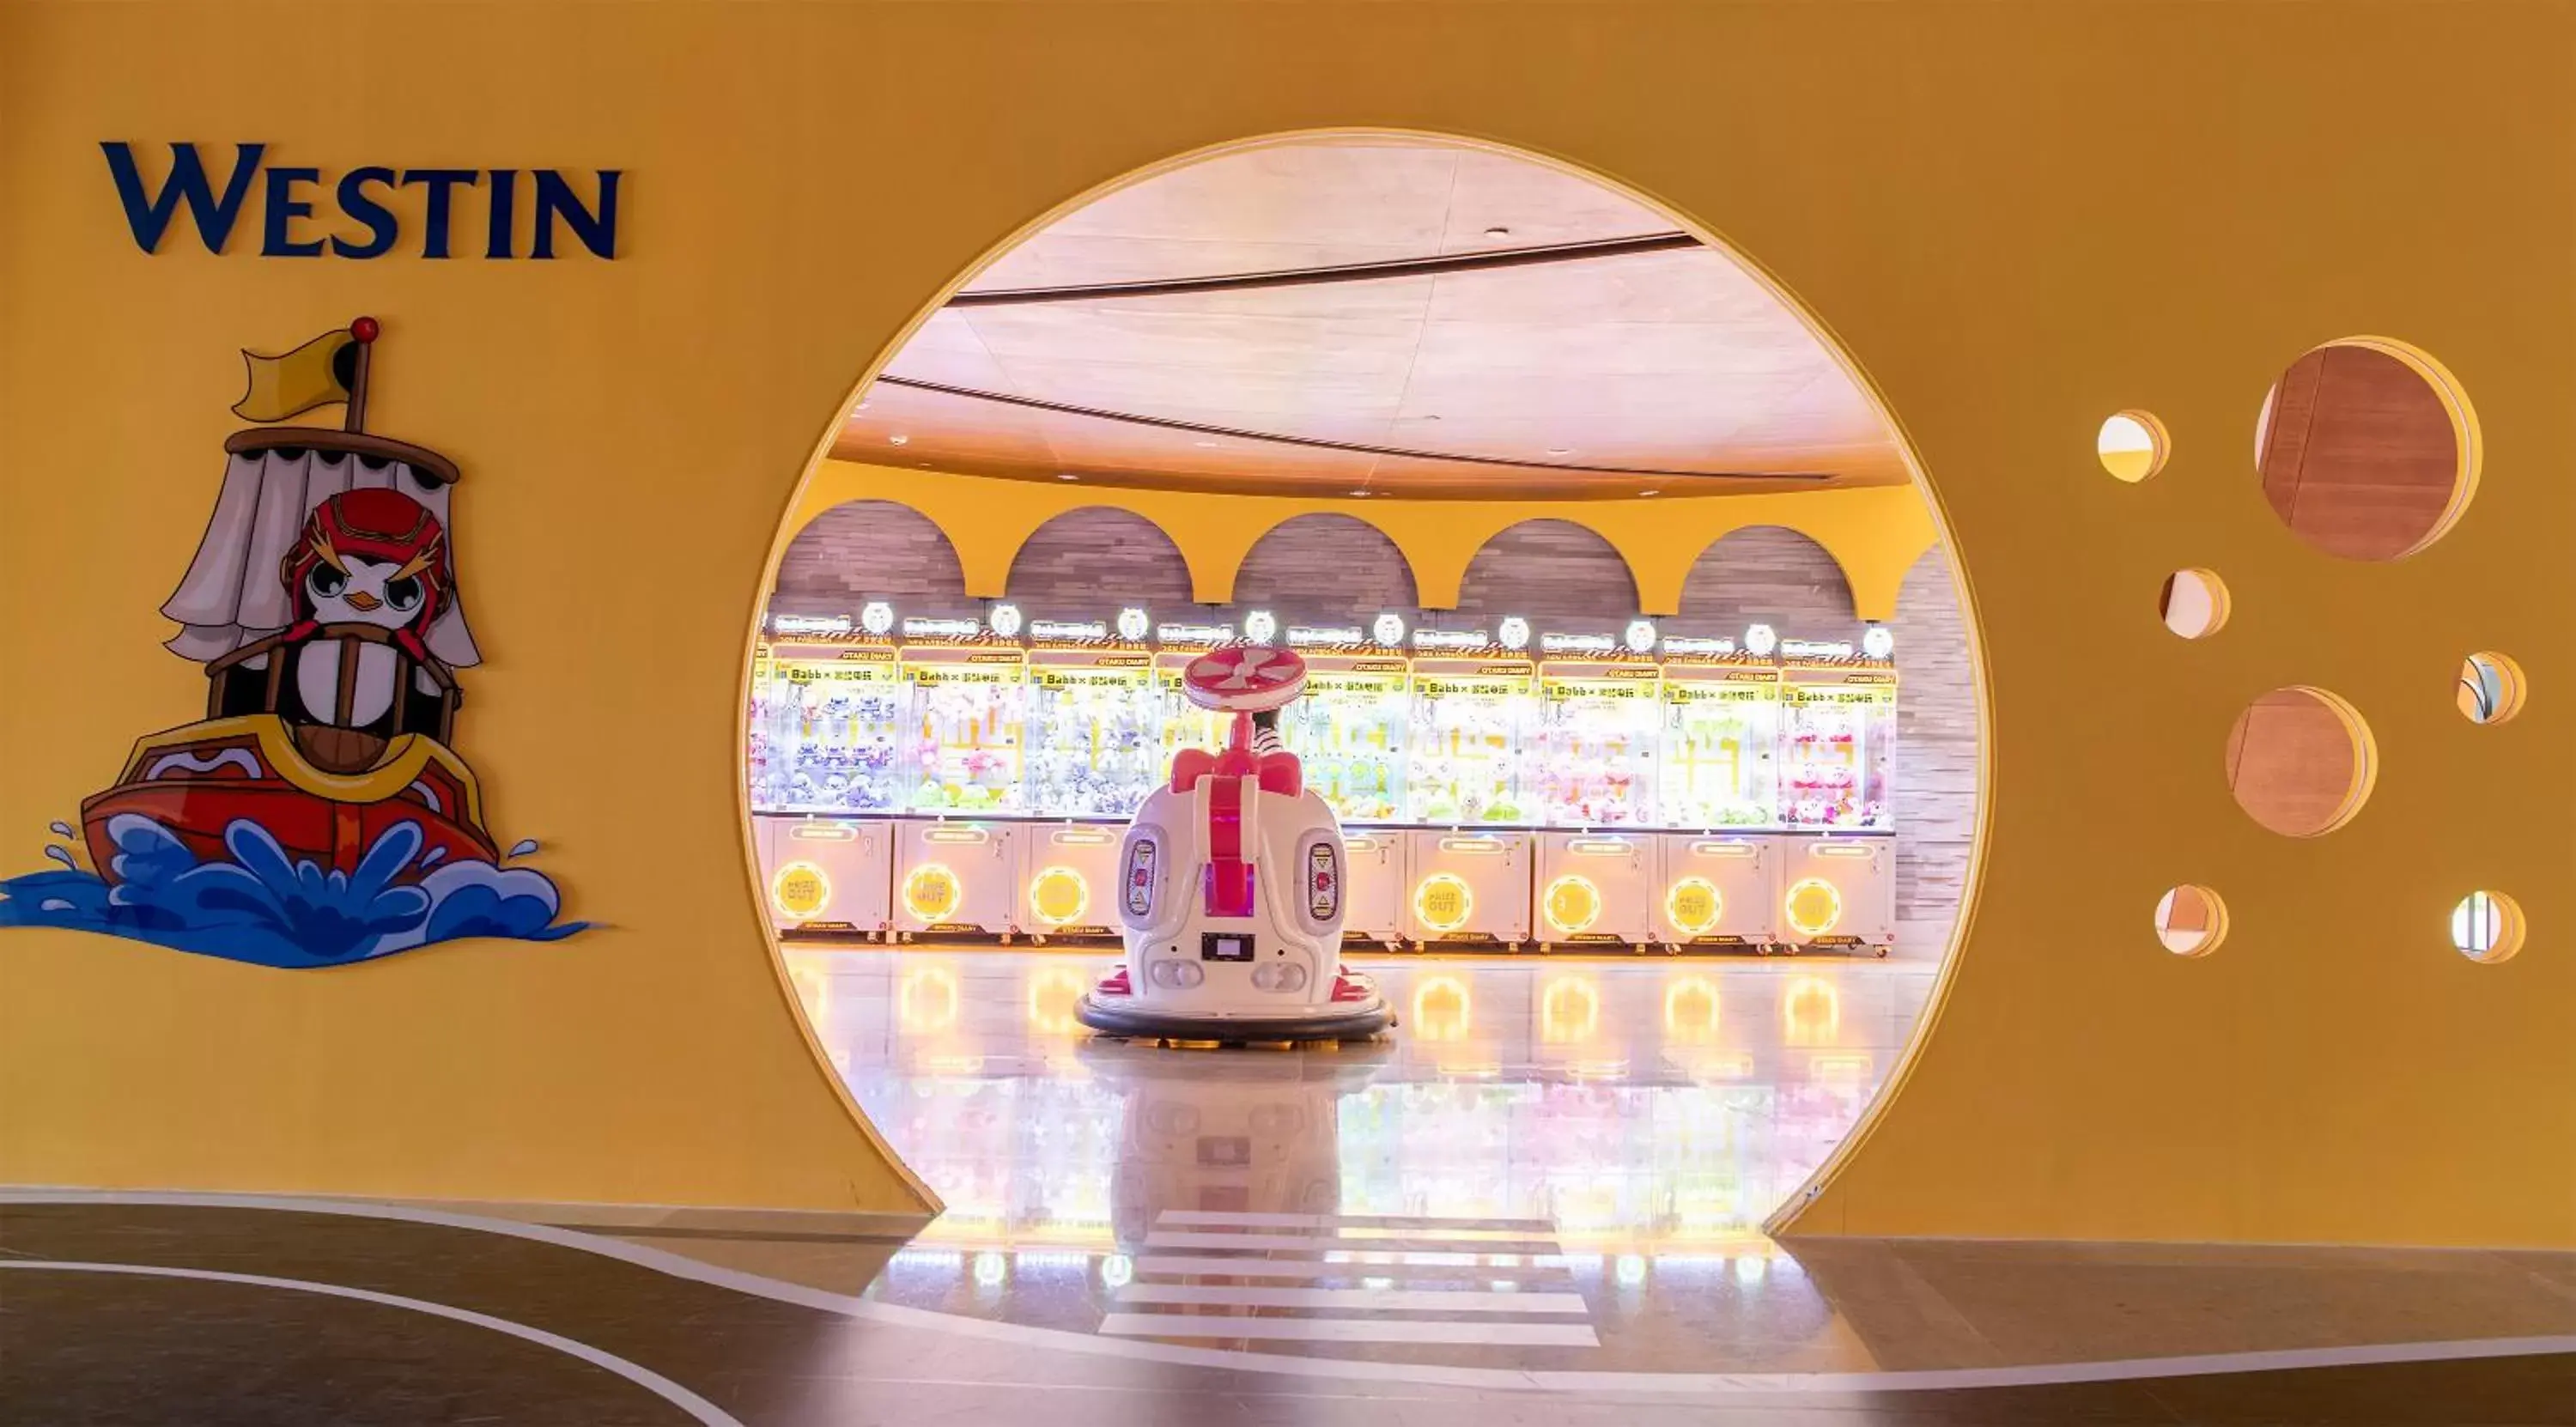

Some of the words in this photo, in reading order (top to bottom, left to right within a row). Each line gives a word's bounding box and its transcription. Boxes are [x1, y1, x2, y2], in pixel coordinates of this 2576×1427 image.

[100, 141, 624, 260] WESTIN
[1430, 683, 1459, 693] Babb
[1428, 902, 1456, 912] OUT
[1679, 904, 1705, 915] OUT
